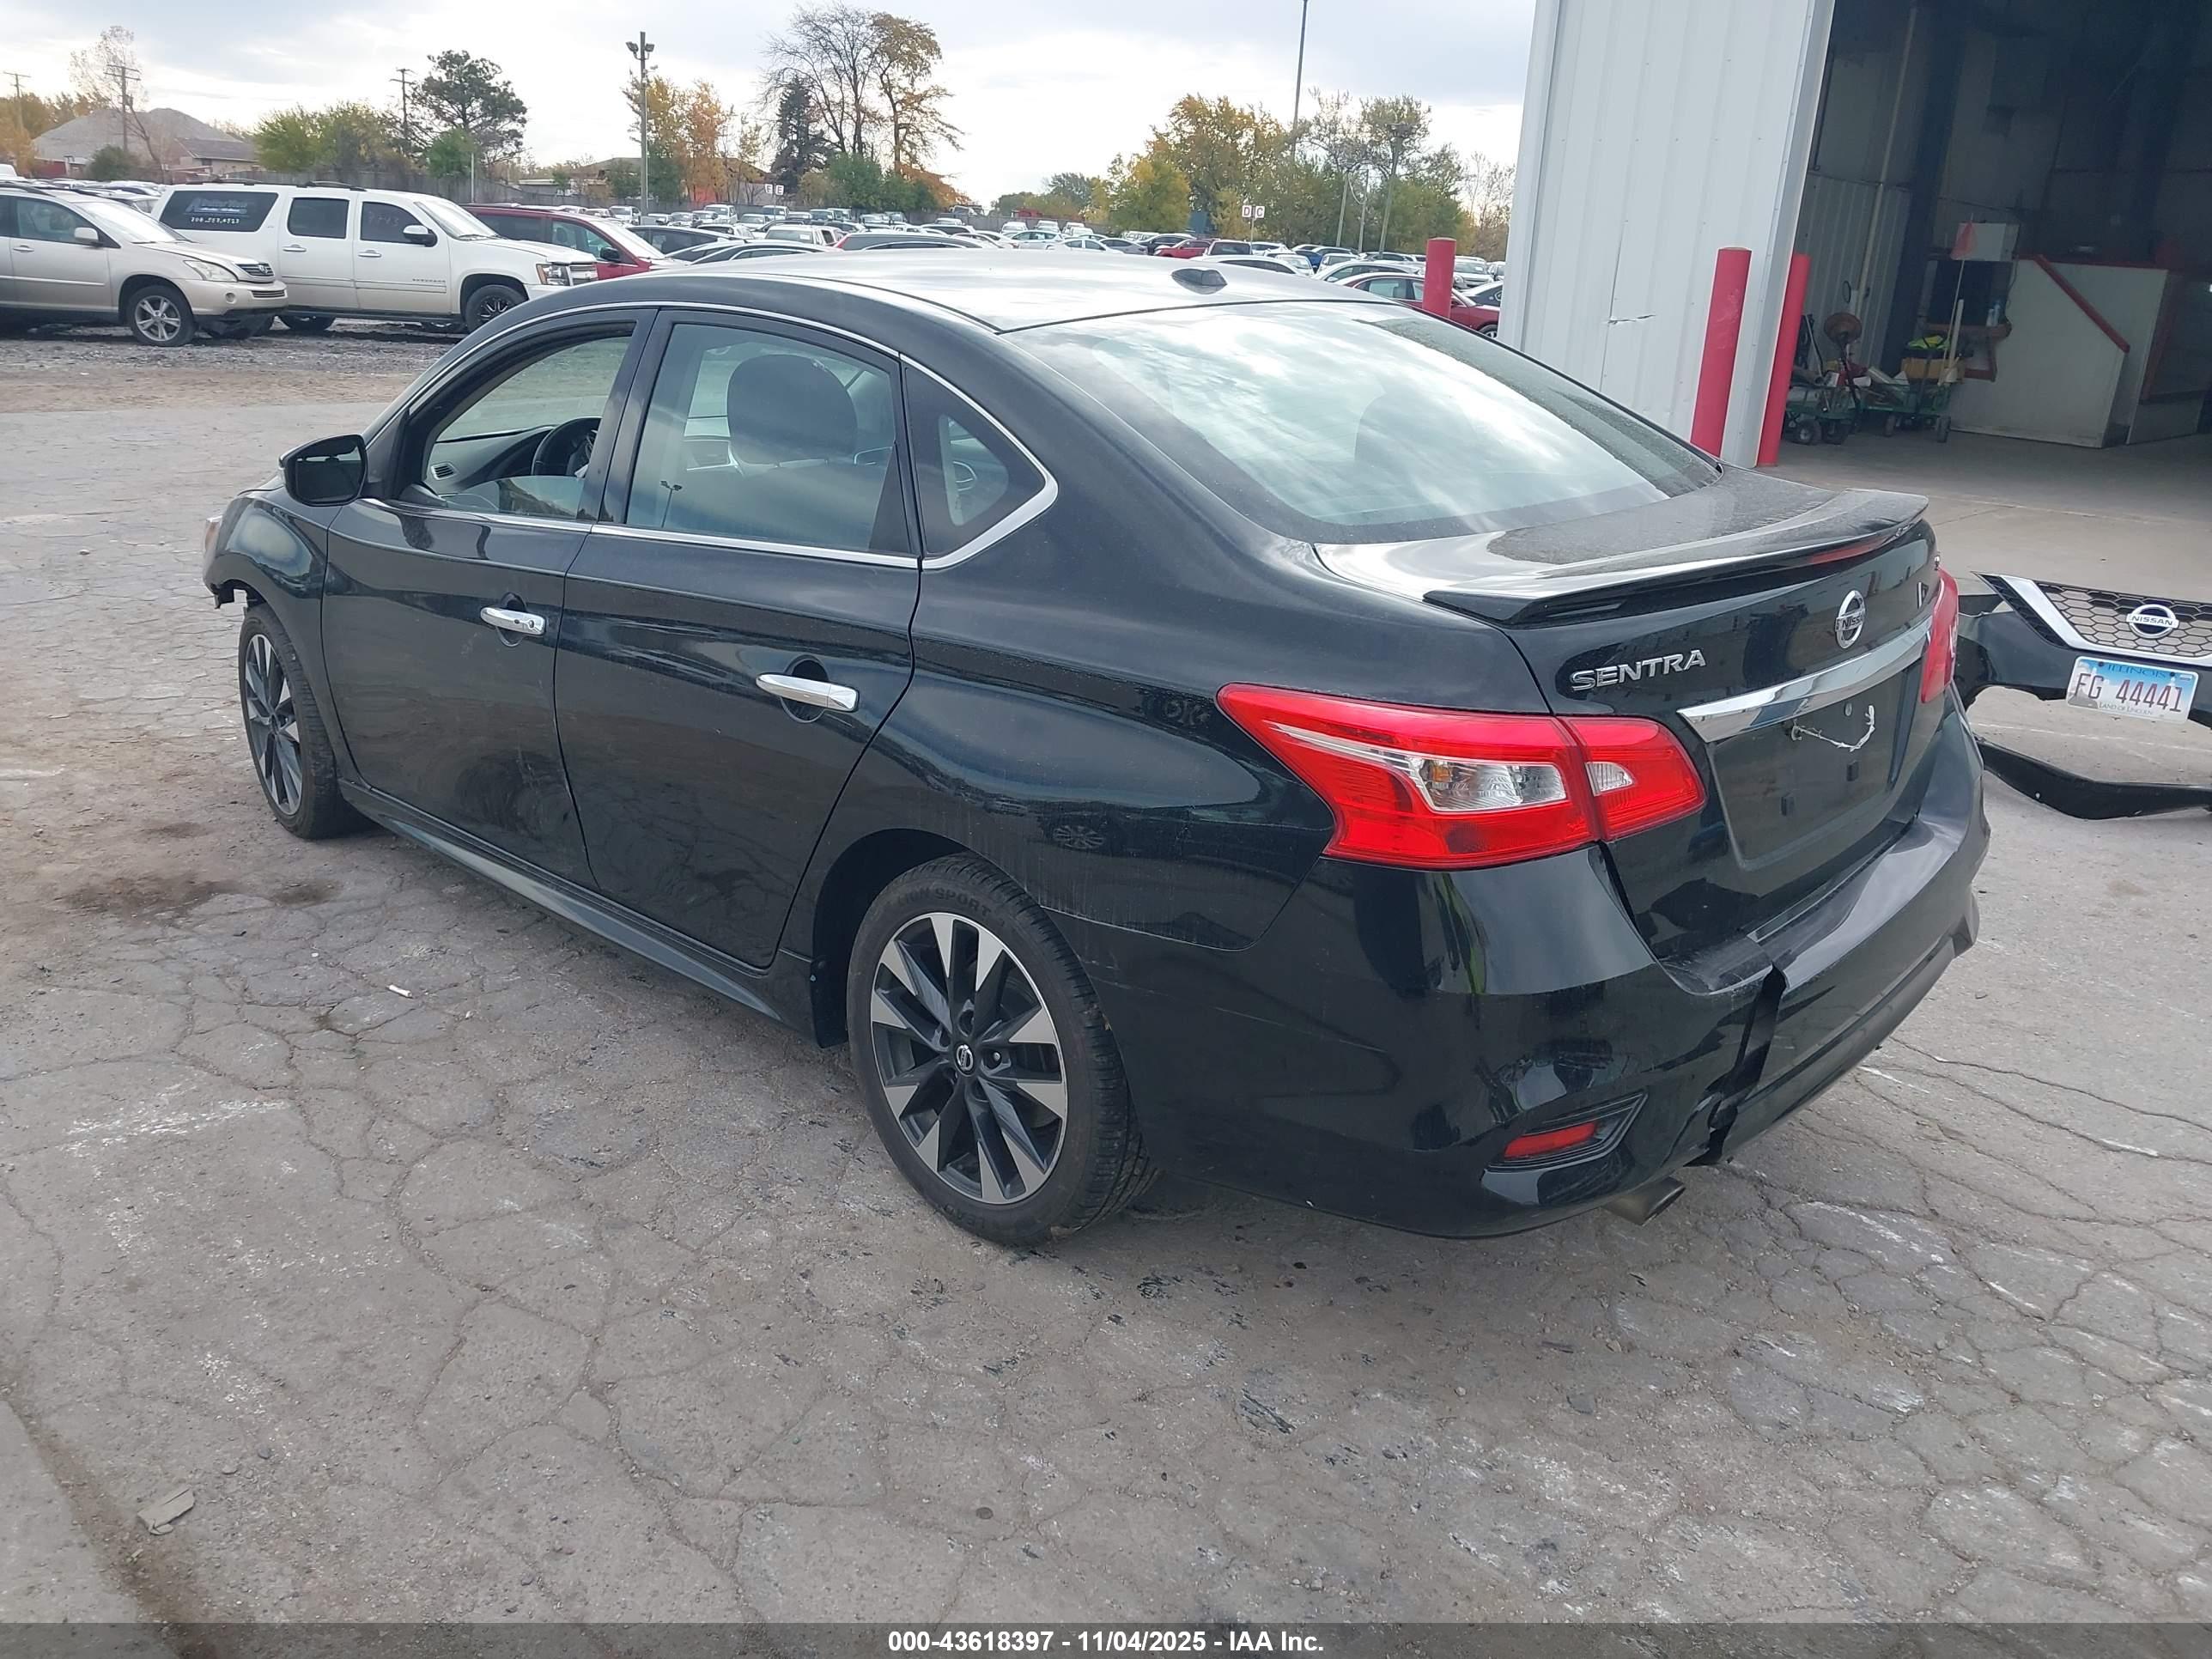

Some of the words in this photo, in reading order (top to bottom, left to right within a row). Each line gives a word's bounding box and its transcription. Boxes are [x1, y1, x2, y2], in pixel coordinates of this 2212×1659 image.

[2131, 615, 2173, 626] NISSAN
[1571, 649, 1706, 691] SENTRA
[2107, 664, 2167, 678] ILLINOIS
[2075, 673, 2105, 700] FG
[2116, 679, 2183, 713] 44441
[934, 887, 992, 916] SPORT
